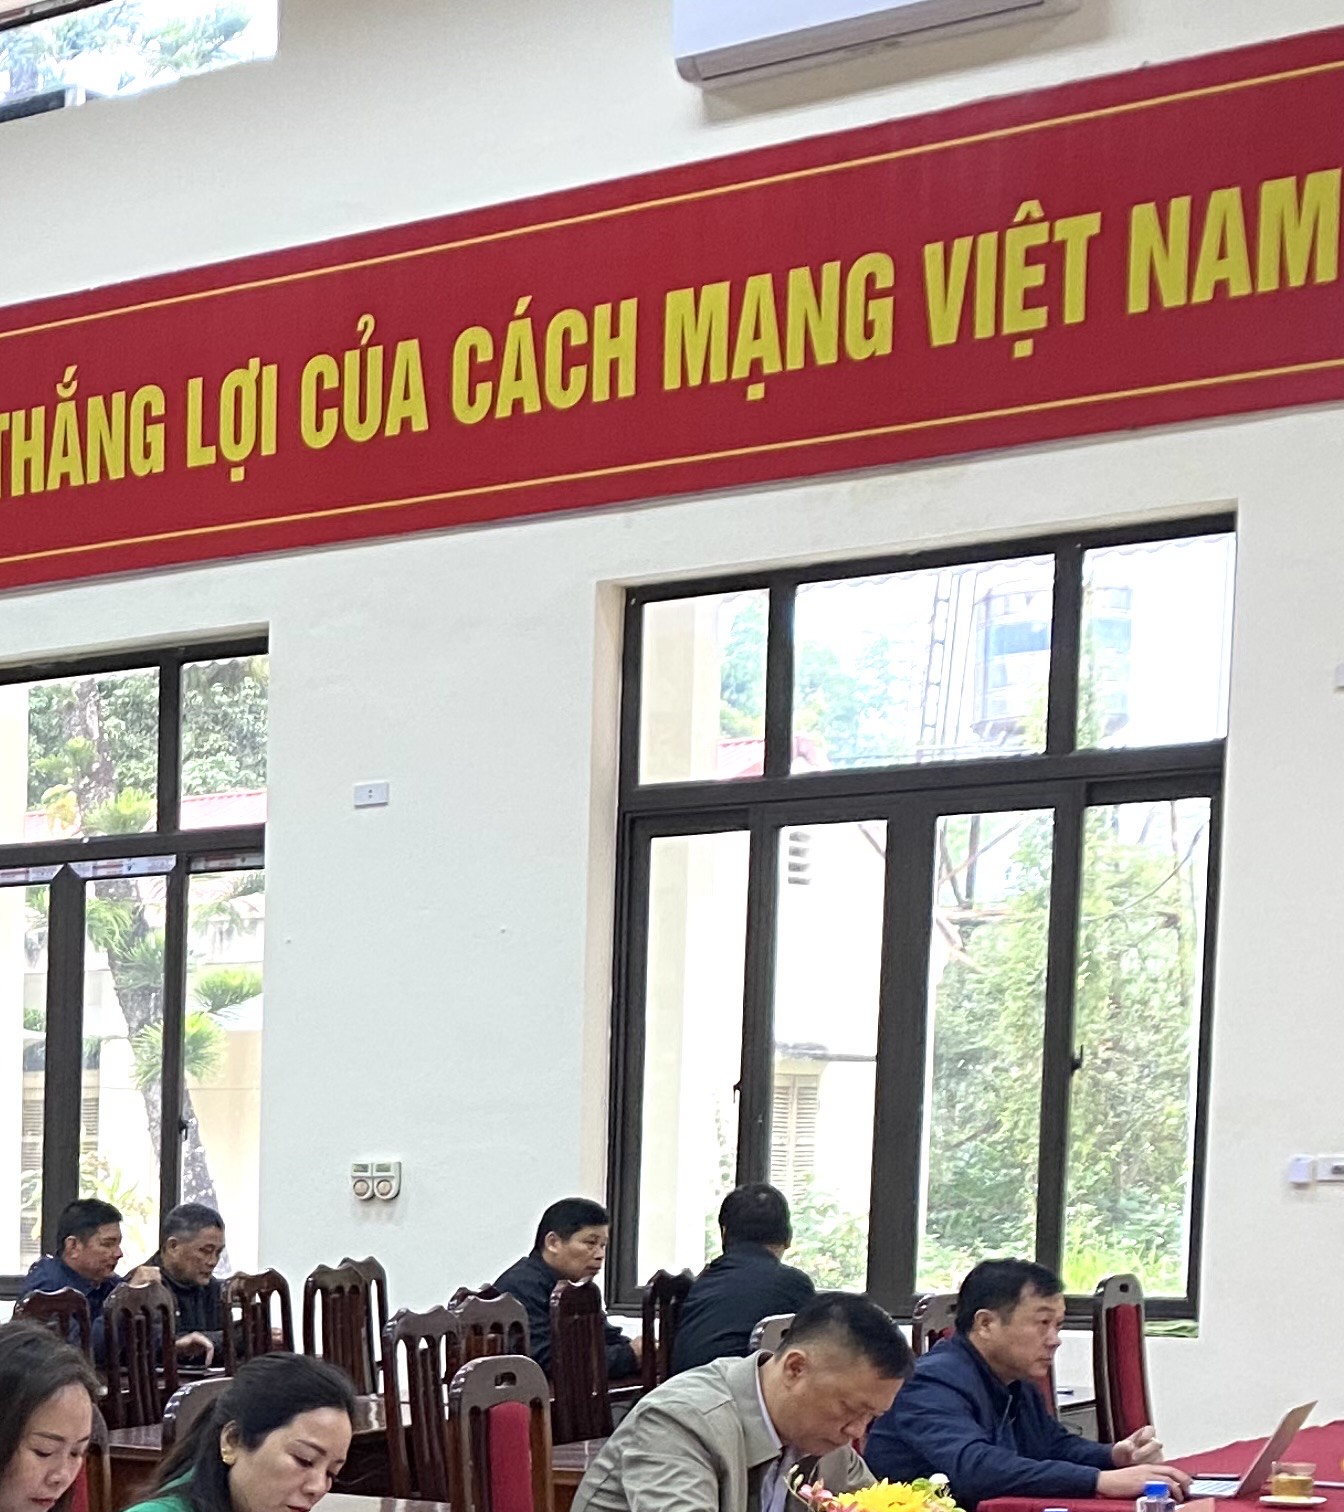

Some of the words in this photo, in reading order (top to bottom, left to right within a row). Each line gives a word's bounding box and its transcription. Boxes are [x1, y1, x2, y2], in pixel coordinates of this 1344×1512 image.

[186, 358, 278, 482] LỢI
[300, 315, 428, 450] CỦA
[451, 297, 637, 425] CÁCH
[662, 252, 894, 402] MẠNG
[923, 201, 1100, 358] VIỆT
[1127, 169, 1341, 313] NAM
